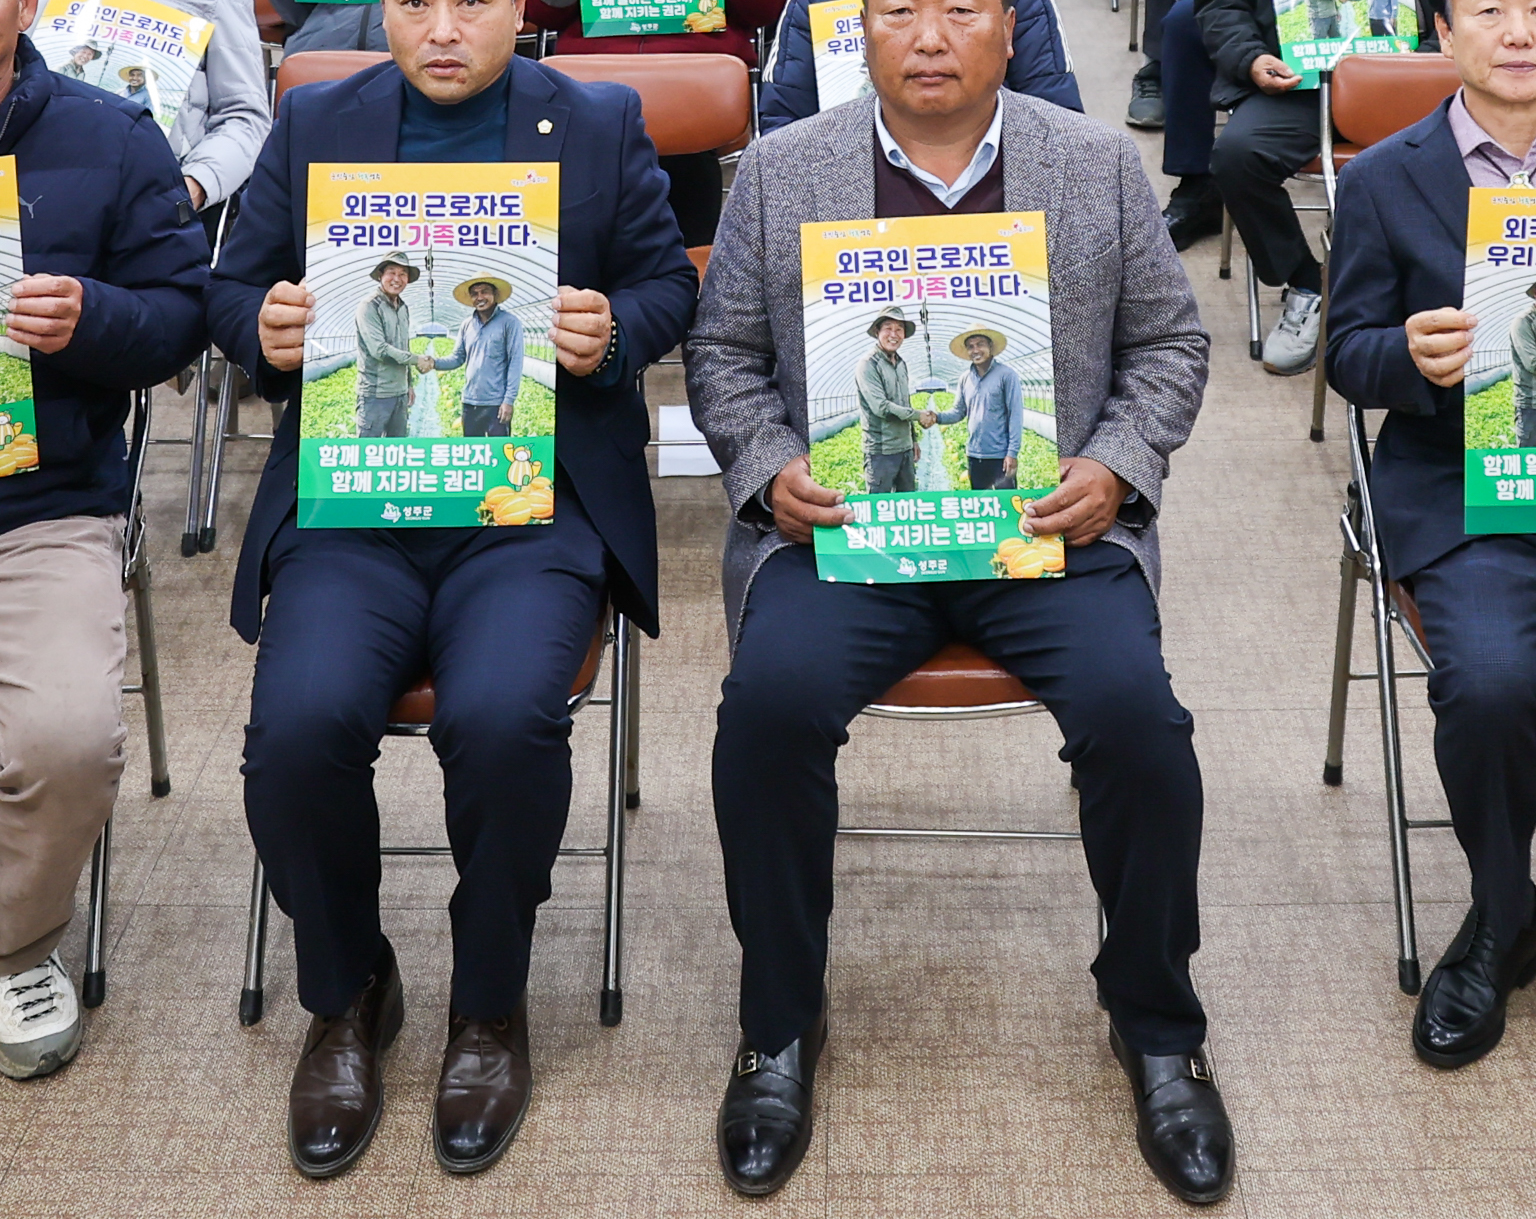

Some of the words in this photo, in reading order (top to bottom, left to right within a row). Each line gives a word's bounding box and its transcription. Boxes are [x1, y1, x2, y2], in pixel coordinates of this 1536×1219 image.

[599, 7, 623, 20] 함께
[624, 6, 660, 18] 지키는
[663, 4, 686, 17] 권리
[119, 11, 185, 41] 근로자도
[102, 25, 187, 60] 가족입니다.
[344, 194, 416, 218] 외국인
[425, 194, 521, 218] 근로자도
[327, 223, 399, 247] 우리의
[408, 223, 537, 247] 가족입니다.
[837, 249, 908, 276] 외국인
[915, 244, 1011, 272] 근로자도
[822, 278, 894, 305] 우리의
[901, 272, 1029, 301] 가족입니다.
[319, 444, 359, 467] 함께
[365, 444, 425, 466] 일하는
[431, 444, 498, 466] 동반자,
[1481, 453, 1520, 475] 함께
[331, 471, 372, 493] 함께
[376, 471, 438, 493] 지키는
[444, 470, 483, 492] 권리
[1493, 478, 1532, 500] 함께
[876, 498, 937, 521] 일하는
[940, 496, 1007, 520] 동반자,
[845, 526, 887, 549] 함께
[889, 525, 951, 547] 지키는
[956, 523, 995, 545] 권리
